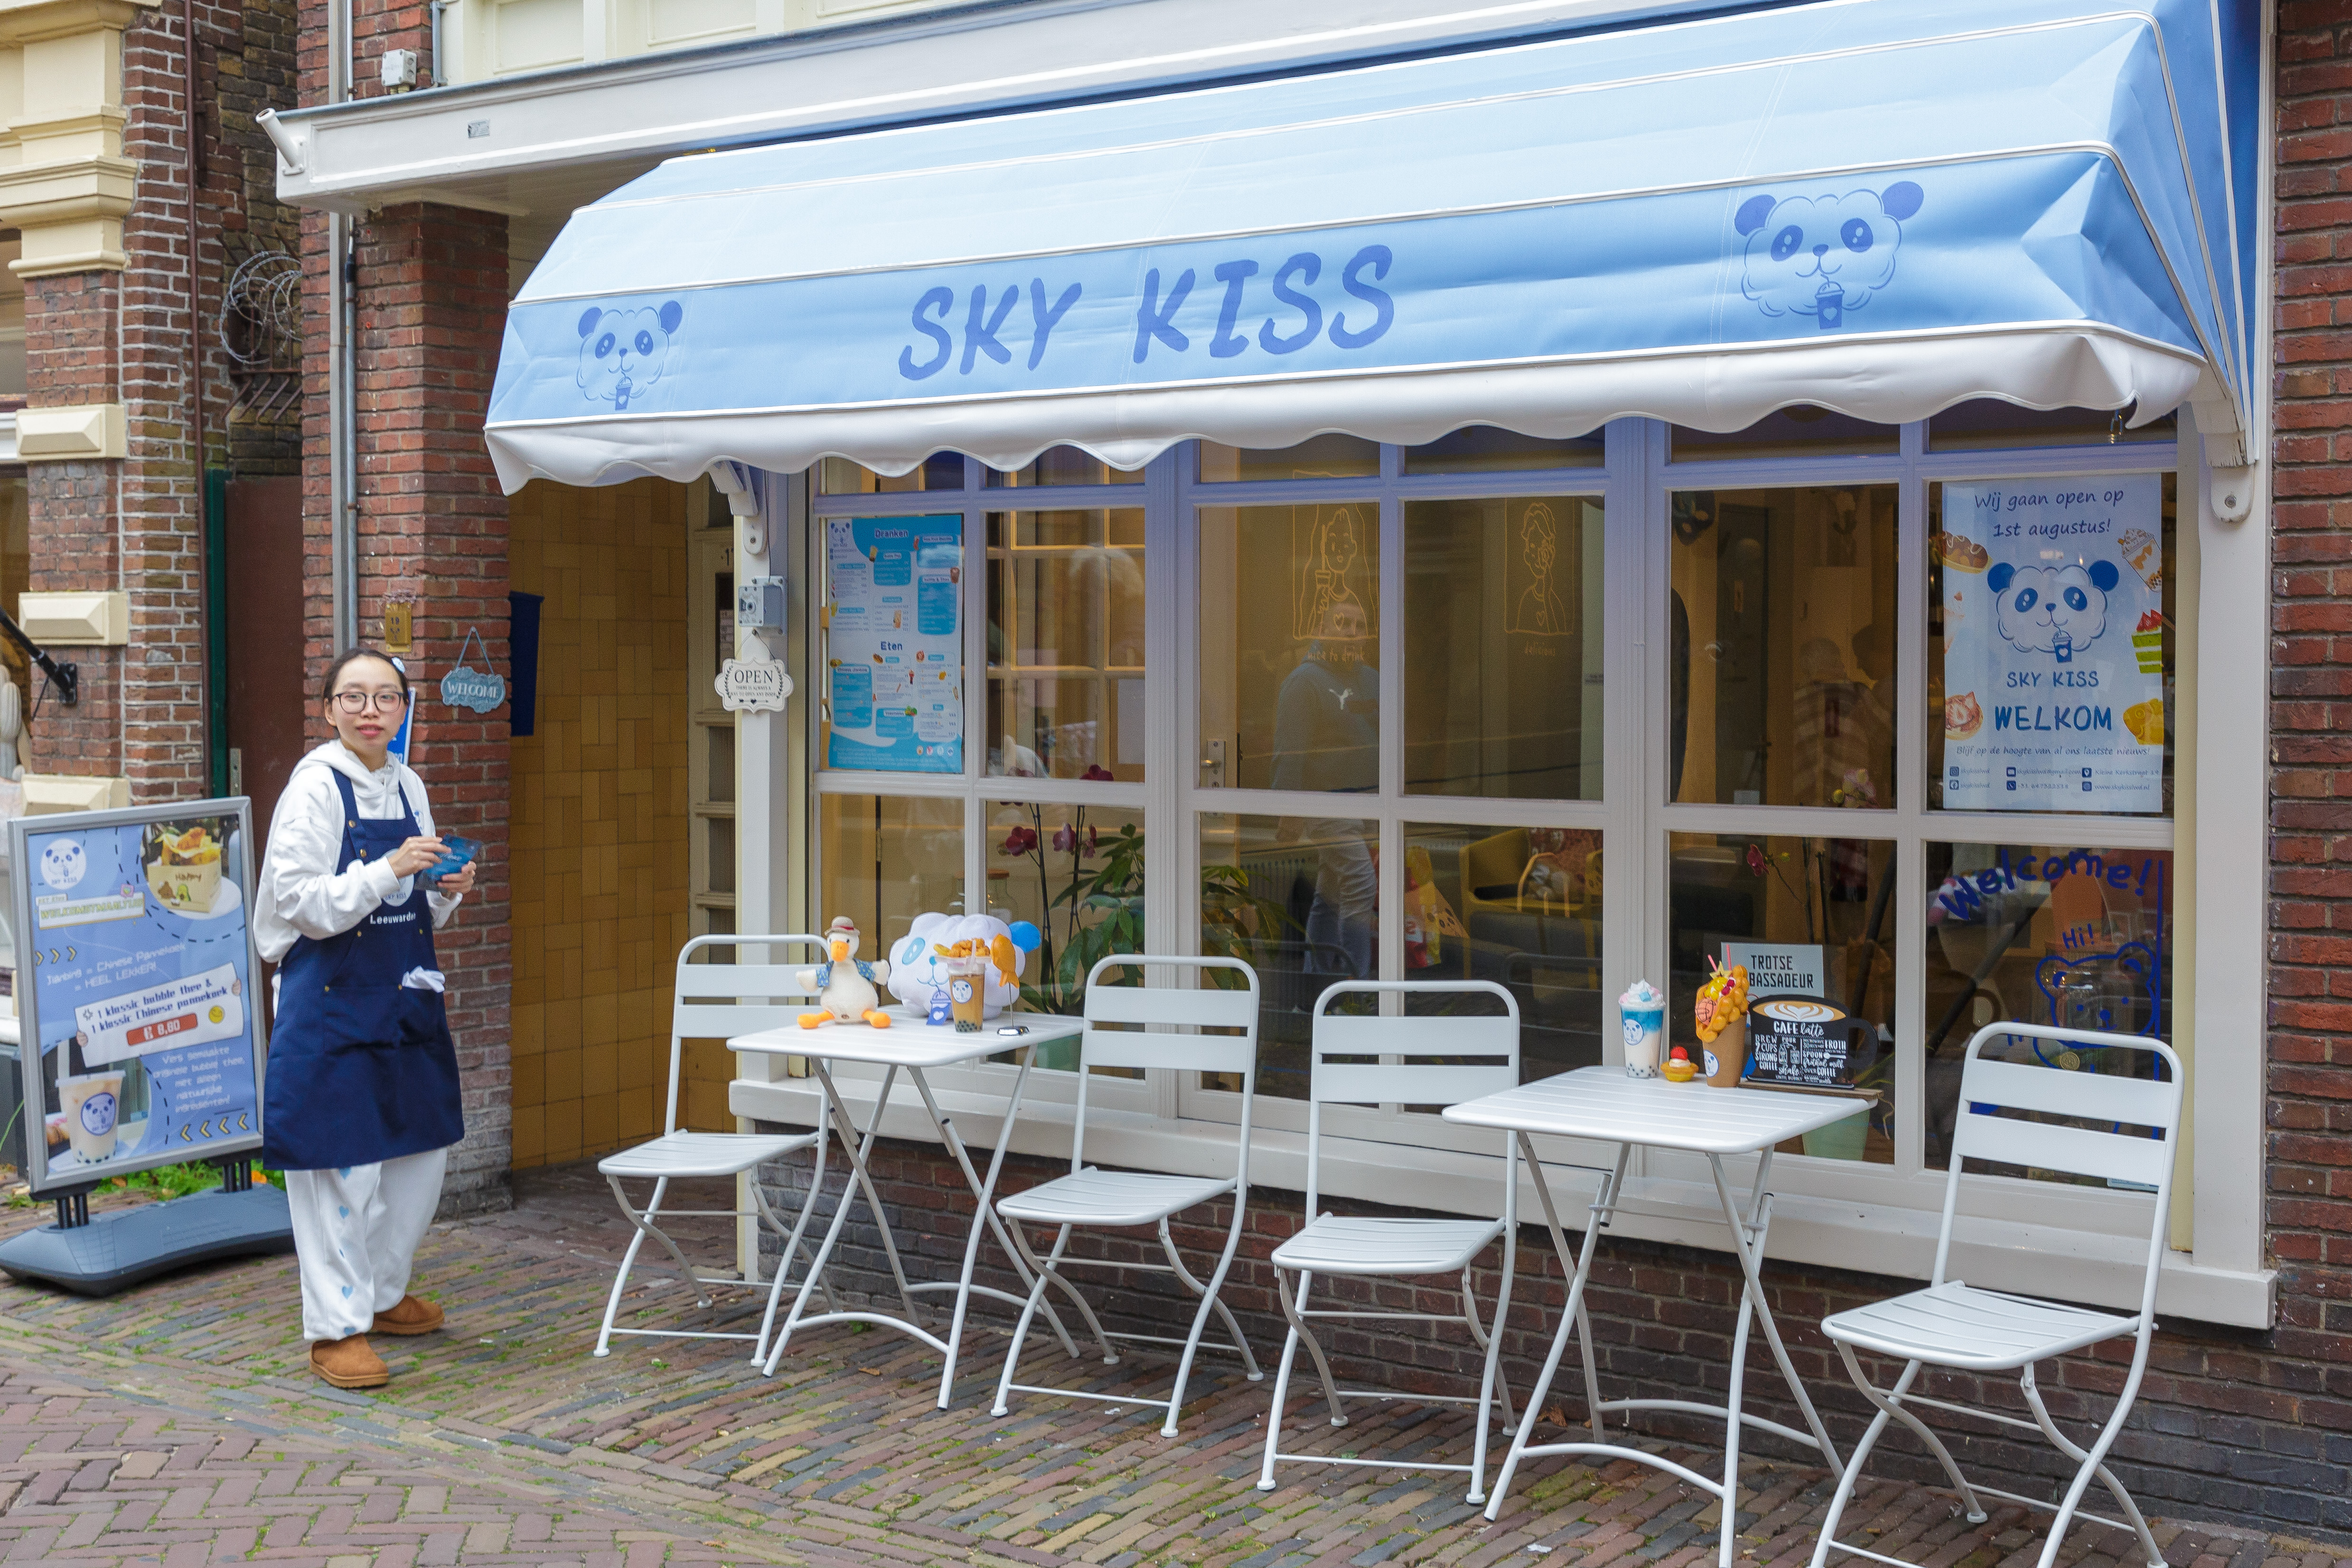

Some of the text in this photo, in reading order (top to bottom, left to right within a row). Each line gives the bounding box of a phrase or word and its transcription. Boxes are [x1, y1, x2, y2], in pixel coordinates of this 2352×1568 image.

[899, 244, 1395, 380] SKY KISS
[1975, 489, 2124, 512] Wij gaan open op
[875, 529, 908, 537] Dranken
[1993, 517, 2111, 539] 1st augustus!
[881, 641, 903, 651] Eten
[735, 669, 773, 683] OPEN
[2006, 670, 2099, 687] SKY KISS
[447, 681, 497, 698] WELCOME
[1995, 705, 2112, 731] WELKOM
[1957, 746, 1974, 756] Blijf
[1977, 748, 1987, 756] op
[1990, 746, 2000, 754] de
[2003, 746, 2032, 757] hoogte
[2054, 746, 2062, 754] al
[2084, 746, 2113, 755] laatste
[2117, 746, 2150, 755] nieuws!
[1939, 849, 2153, 920] Welcome!
[2062, 923, 2093, 949] Hi!
[97, 957, 133, 972] Chinese
[1751, 955, 1793, 970] TROTSE
[85, 975, 112, 988] HEEL
[1749, 972, 1813, 988] BASSADEUR
[105, 999, 139, 1016] klassic
[143, 990, 175, 1005] bubble
[180, 982, 202, 995] thee
[205, 977, 212, 987] &
[99, 1015, 131, 1032] klassic
[136, 1004, 173, 1020] Chinese
[177, 986, 228, 1010] pannekoek
[1773, 1021, 1824, 1037] CAFE latte
[1755, 1034, 1777, 1043] BREW
[1825, 1039, 1846, 1051] FROTH
[1761, 1042, 1778, 1053] CUPS
[1803, 1050, 1823, 1059] SPOON
[1755, 1052, 1778, 1062] STRONG
[1759, 1061, 1778, 1071] COFFEE
[1779, 1064, 1800, 1077] shake
[1817, 1067, 1836, 1077] COFFEE
